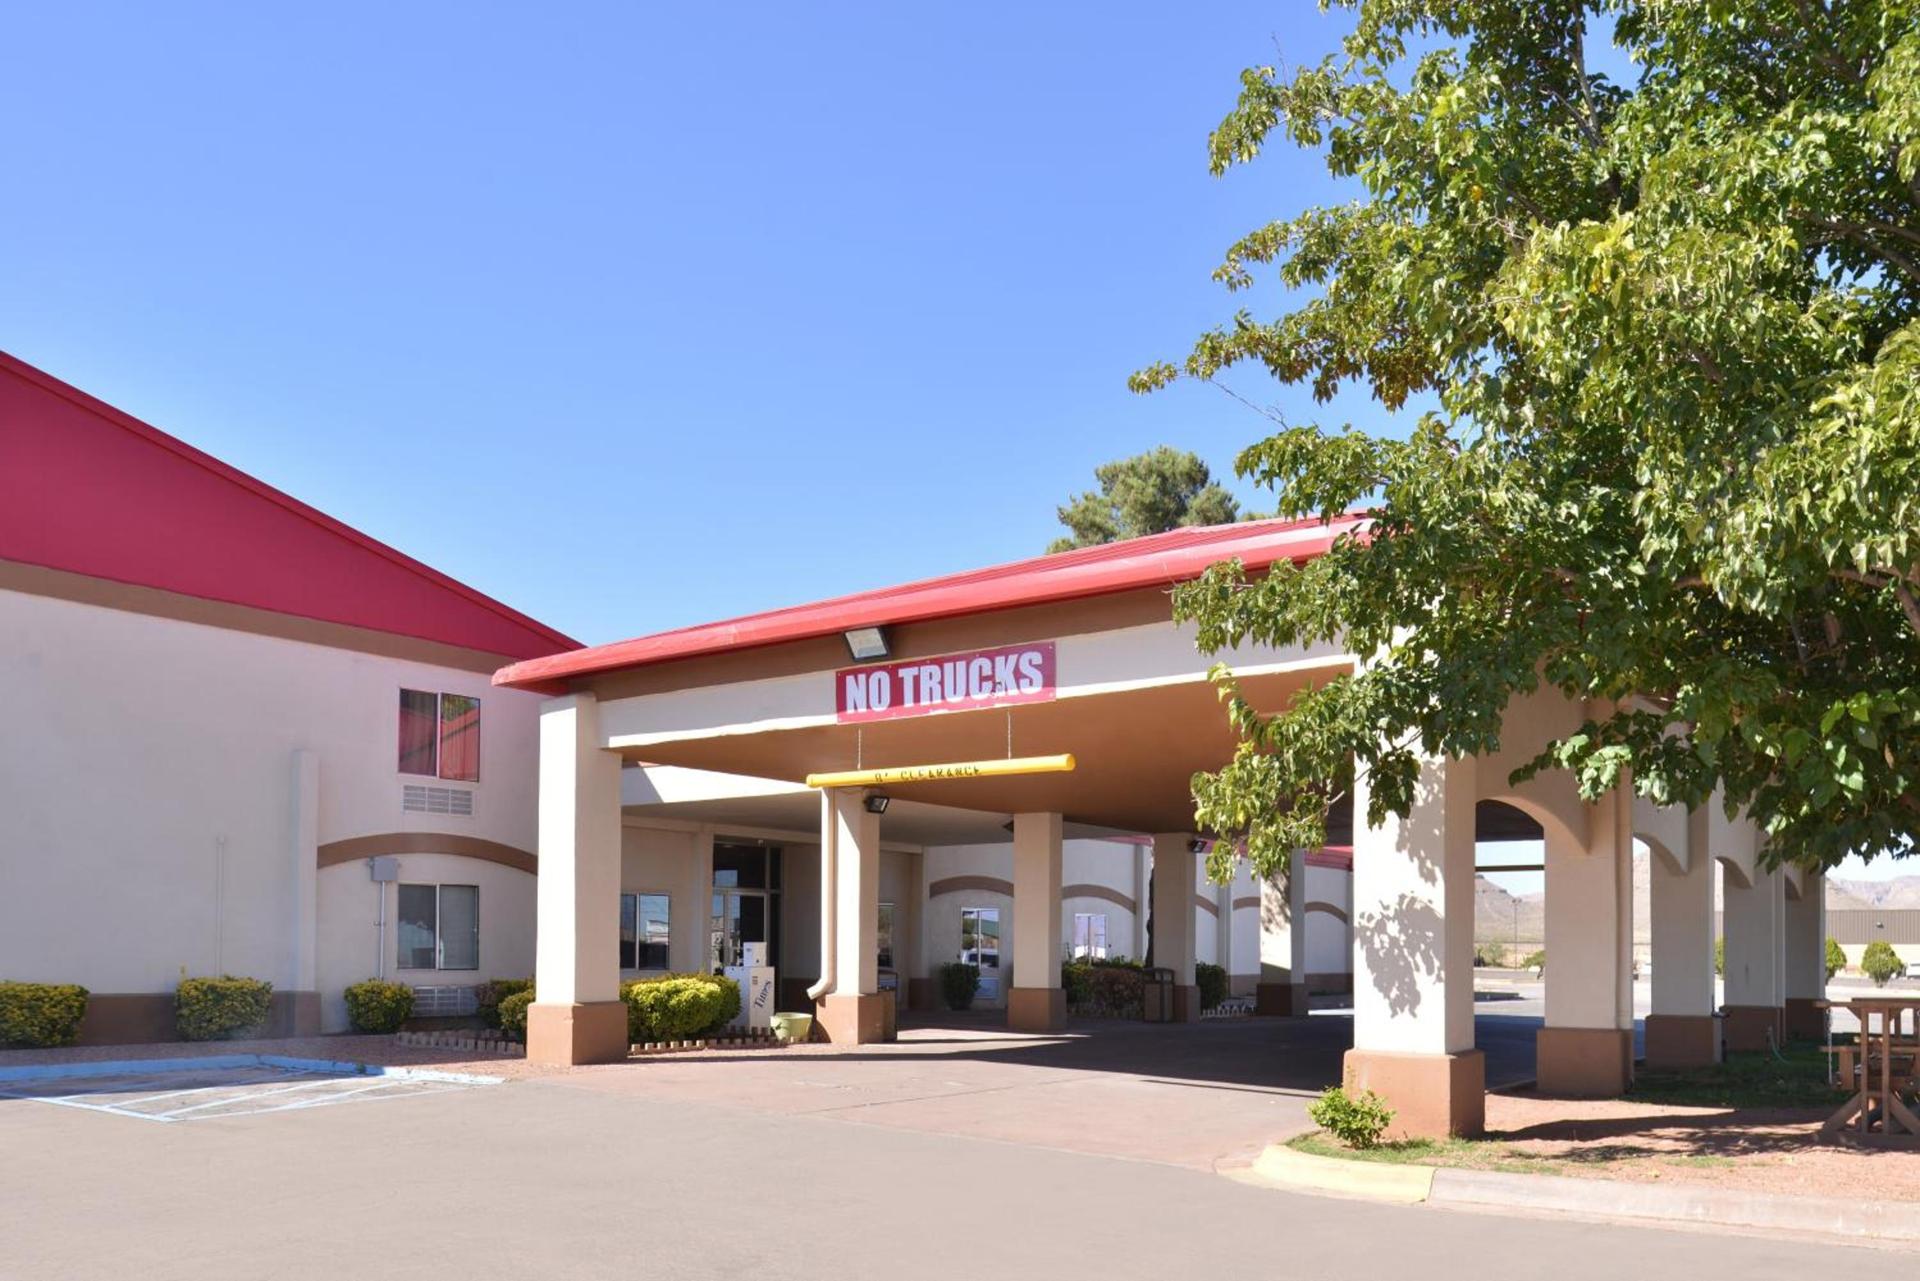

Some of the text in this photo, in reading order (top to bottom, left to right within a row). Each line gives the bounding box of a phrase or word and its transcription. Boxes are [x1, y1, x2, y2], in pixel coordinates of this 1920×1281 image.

[845, 651, 1043, 714] NO TRUCKS
[900, 765, 979, 780] CLEARANCE
